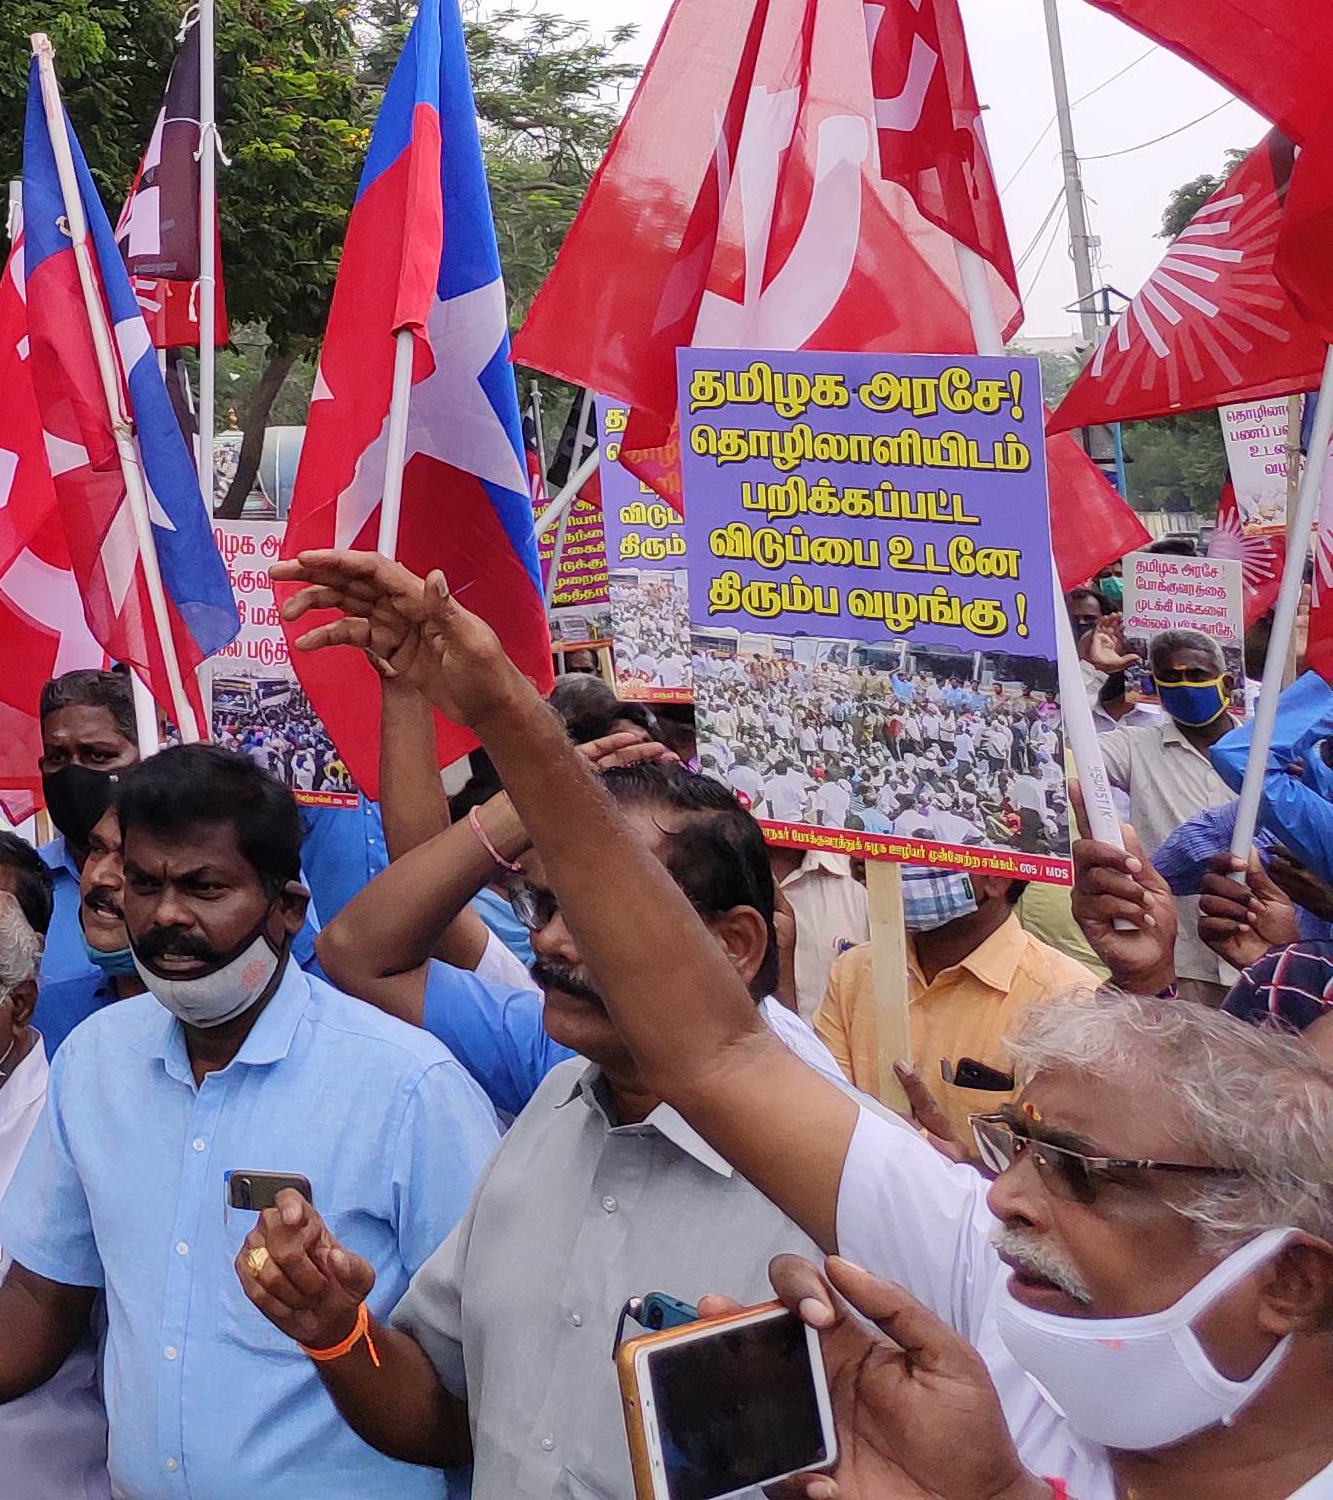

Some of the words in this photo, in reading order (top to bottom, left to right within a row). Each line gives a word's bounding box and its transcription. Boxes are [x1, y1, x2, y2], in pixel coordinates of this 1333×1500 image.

[689, 361, 848, 419] தமிழக
[858, 367, 1023, 421] அரசே!
[690, 423, 1030, 472] தொழிலாளியிடம்
[742, 475, 980, 524] பறிக்கப்பட்ட
[709, 522, 880, 570] விடுப்பை
[889, 536, 1021, 579] உடனே
[1136, 559, 1178, 578] தமிழக
[708, 570, 839, 616] திரும்ப
[1045, 866, 1069, 879] MDS
